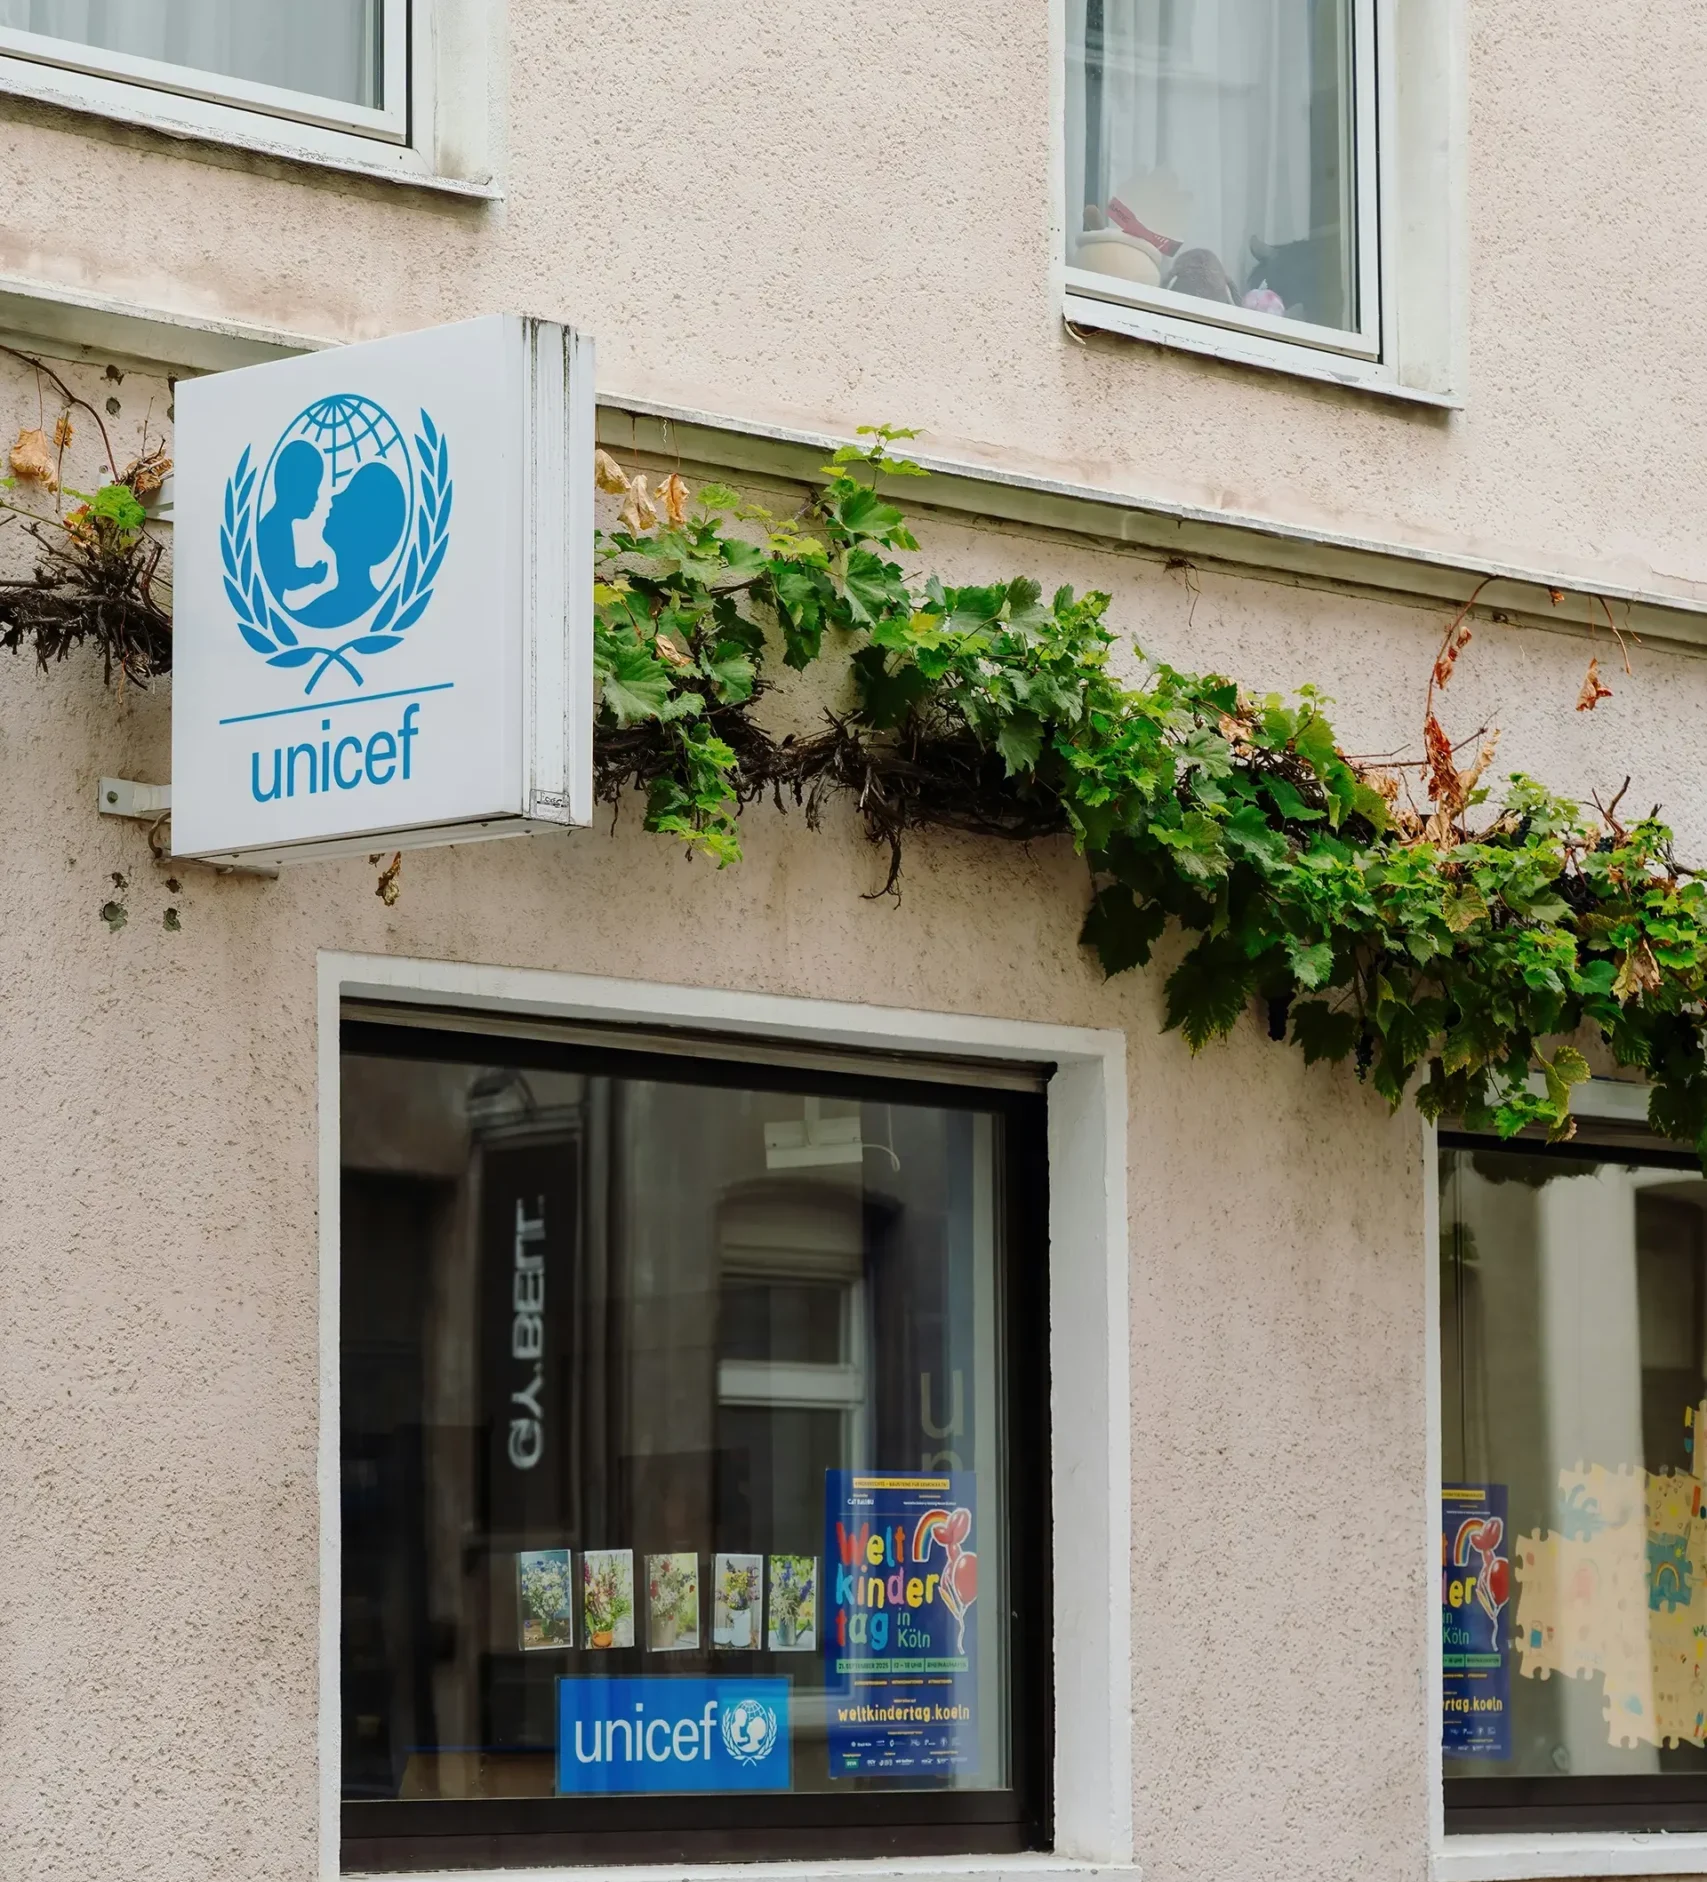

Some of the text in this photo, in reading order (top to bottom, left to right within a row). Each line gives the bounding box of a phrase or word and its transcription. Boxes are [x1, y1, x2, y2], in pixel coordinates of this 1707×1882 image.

[251, 703, 420, 802] unicef
[836, 1522, 905, 1567] Welt
[836, 1563, 940, 1608] kinder
[836, 1609, 889, 1651] tag
[898, 1607, 911, 1626] in
[898, 1628, 931, 1648] Köln
[1443, 1627, 1469, 1645] Köln
[838, 1704, 970, 1722] weltkindertag.koeln
[1442, 1695, 1503, 1713] rtag.koeln
[575, 1700, 718, 1763] unicef
